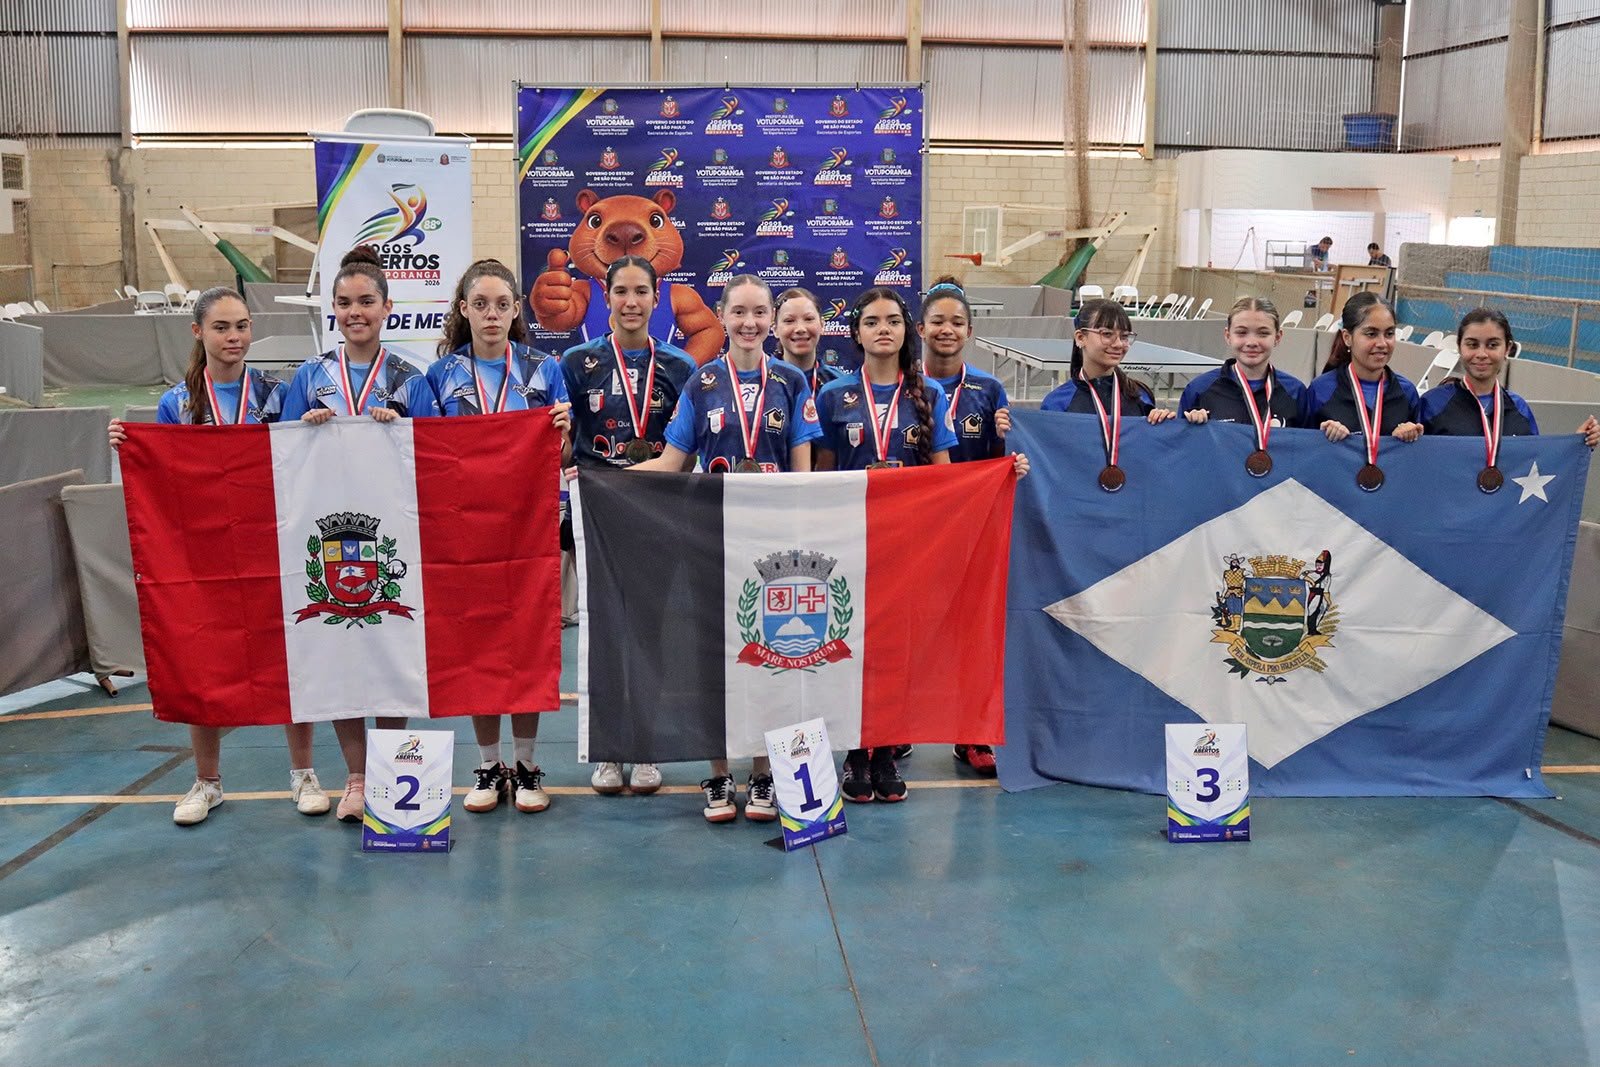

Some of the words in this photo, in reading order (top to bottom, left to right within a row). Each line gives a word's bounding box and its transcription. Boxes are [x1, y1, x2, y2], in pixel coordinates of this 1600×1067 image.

[372, 244, 412, 253] OGOS
[380, 254, 440, 269] ERTOS
[386, 314, 412, 330] DE
[754, 647, 785, 666] MARE
[786, 643, 838, 668] NOSTRUM
[394, 775, 420, 810] 2
[794, 762, 823, 813] 1
[1196, 768, 1221, 803] 3
